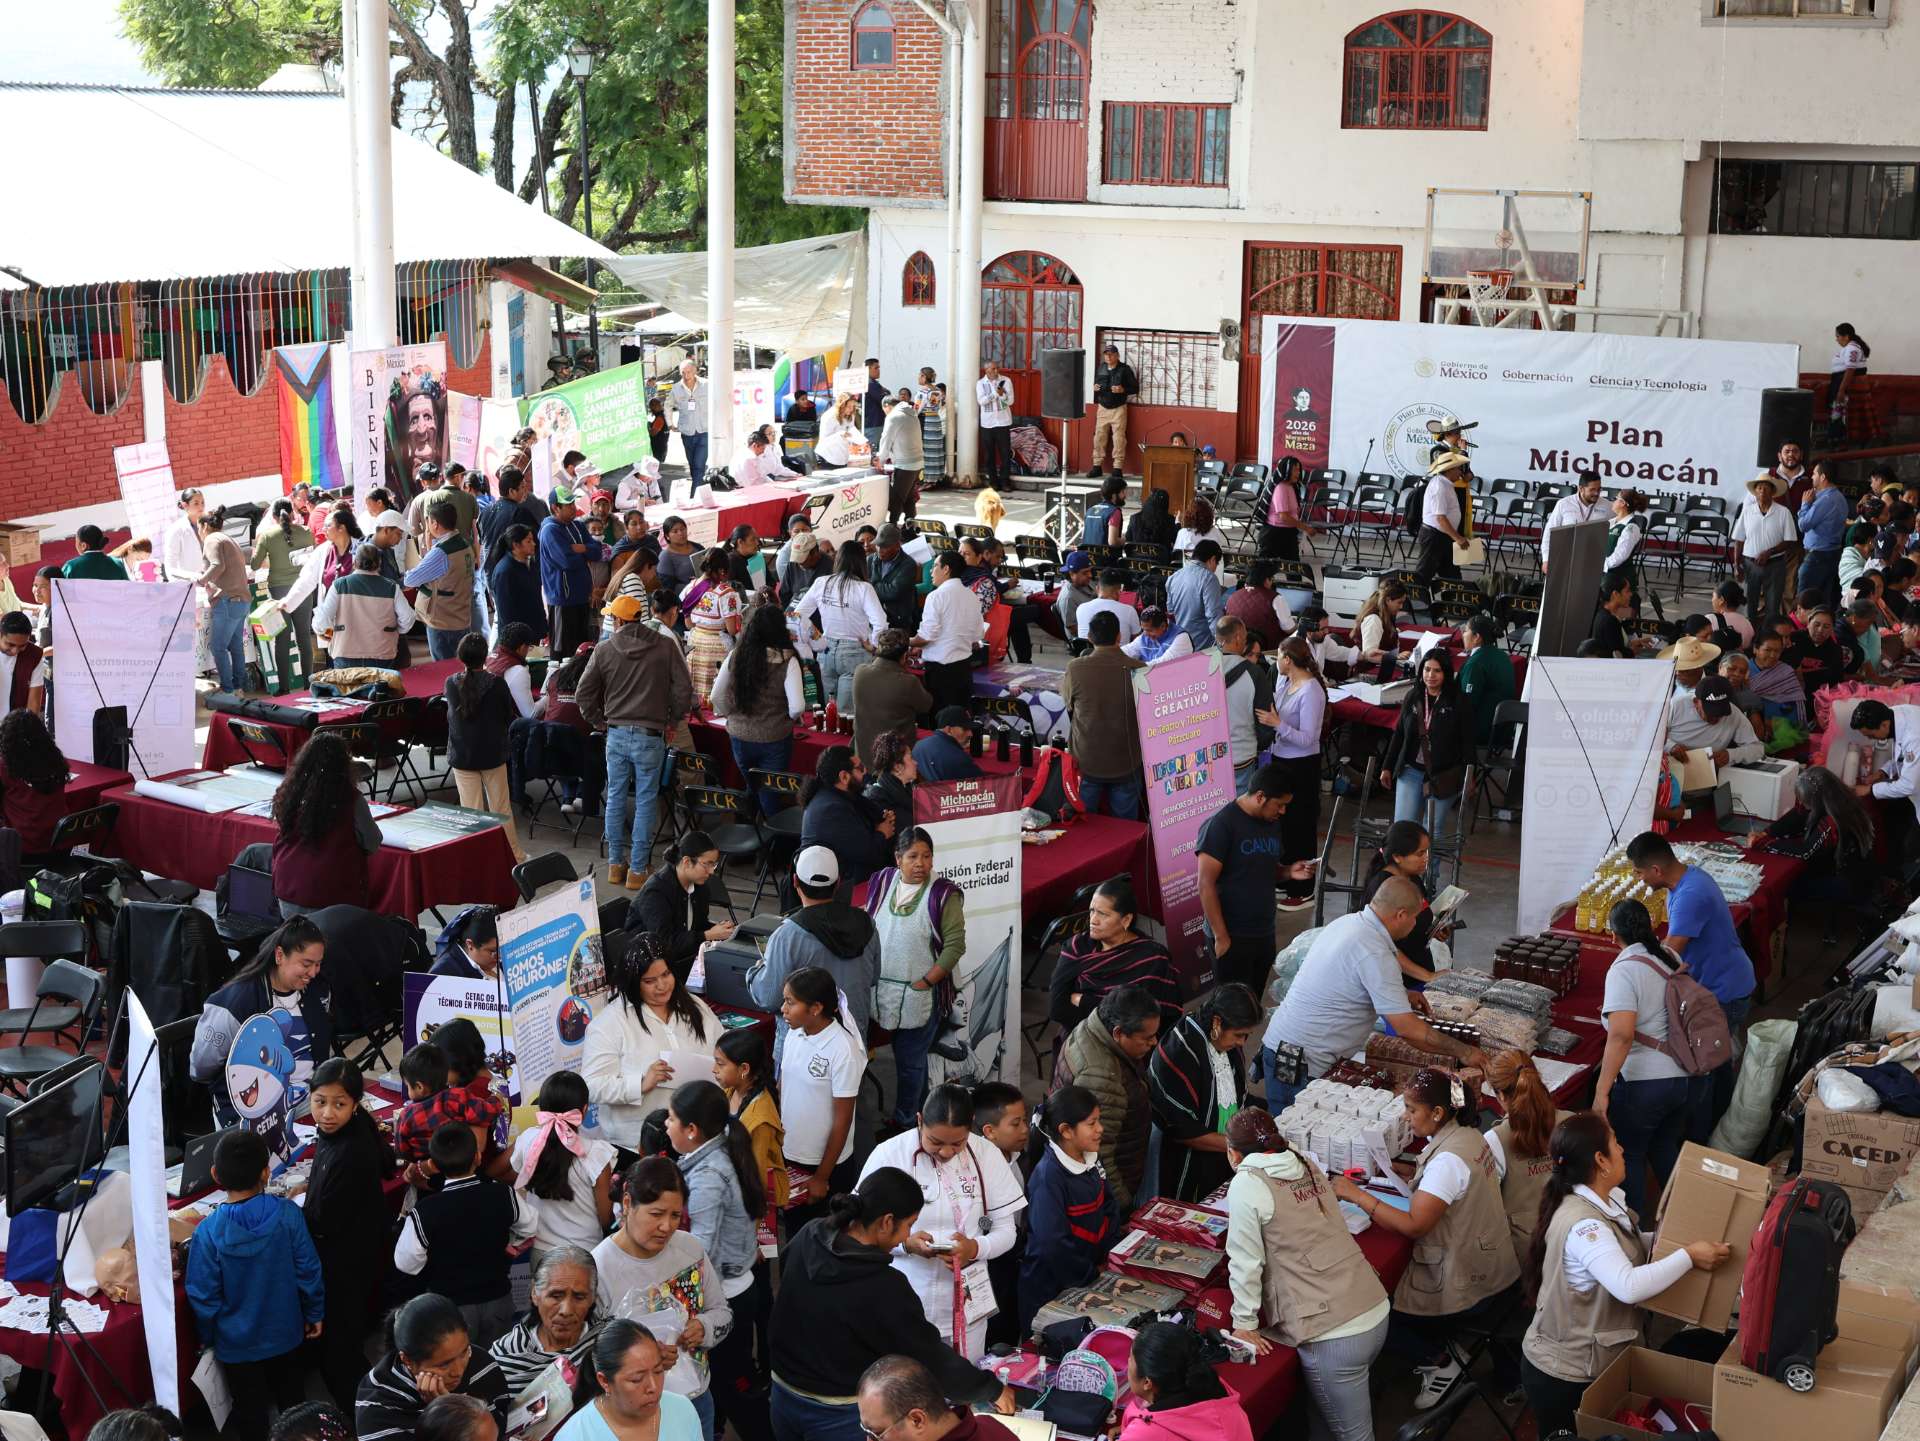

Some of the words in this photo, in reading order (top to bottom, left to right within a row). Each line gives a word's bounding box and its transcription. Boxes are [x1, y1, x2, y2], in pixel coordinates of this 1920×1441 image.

[1440, 360, 1478, 369] Gobierno
[1440, 366, 1488, 381] México
[1502, 368, 1574, 383] Gobernación
[1590, 375, 1633, 388] Ciencia
[1635, 380, 1642, 388] y
[1643, 378, 1707, 393] Tecnología
[1397, 408, 1415, 422] Plan
[1416, 406, 1426, 414] de
[1430, 406, 1448, 418] Justi
[1286, 420, 1316, 432] 2026
[1586, 420, 1663, 448] Plan
[1285, 440, 1316, 451] Maza
[1528, 448, 1719, 486] Michoacán
[832, 504, 872, 530] CORREOS
[964, 526, 986, 537] JCR
[1454, 592, 1480, 604] JCR
[1511, 598, 1538, 610] JCR
[1154, 681, 1208, 705] SEMILLERO
[984, 700, 1019, 715] JCR
[1147, 727, 1156, 738] De
[1158, 722, 1178, 735] Teatro
[1210, 708, 1220, 719] en
[765, 775, 800, 792] JCR
[956, 781, 978, 792] Plan
[702, 792, 737, 809] JCR
[940, 790, 995, 807] Michoacán
[976, 857, 1014, 874] Federal
[507, 952, 544, 980] SOMOS
[508, 955, 568, 996] TIBURONES
[438, 996, 462, 1008] TÉCNICO
[464, 1000, 472, 1009] EN
[466, 992, 484, 1002] CETAC
[485, 993, 495, 1002] 09
[1822, 1140, 1901, 1164] CACEP
